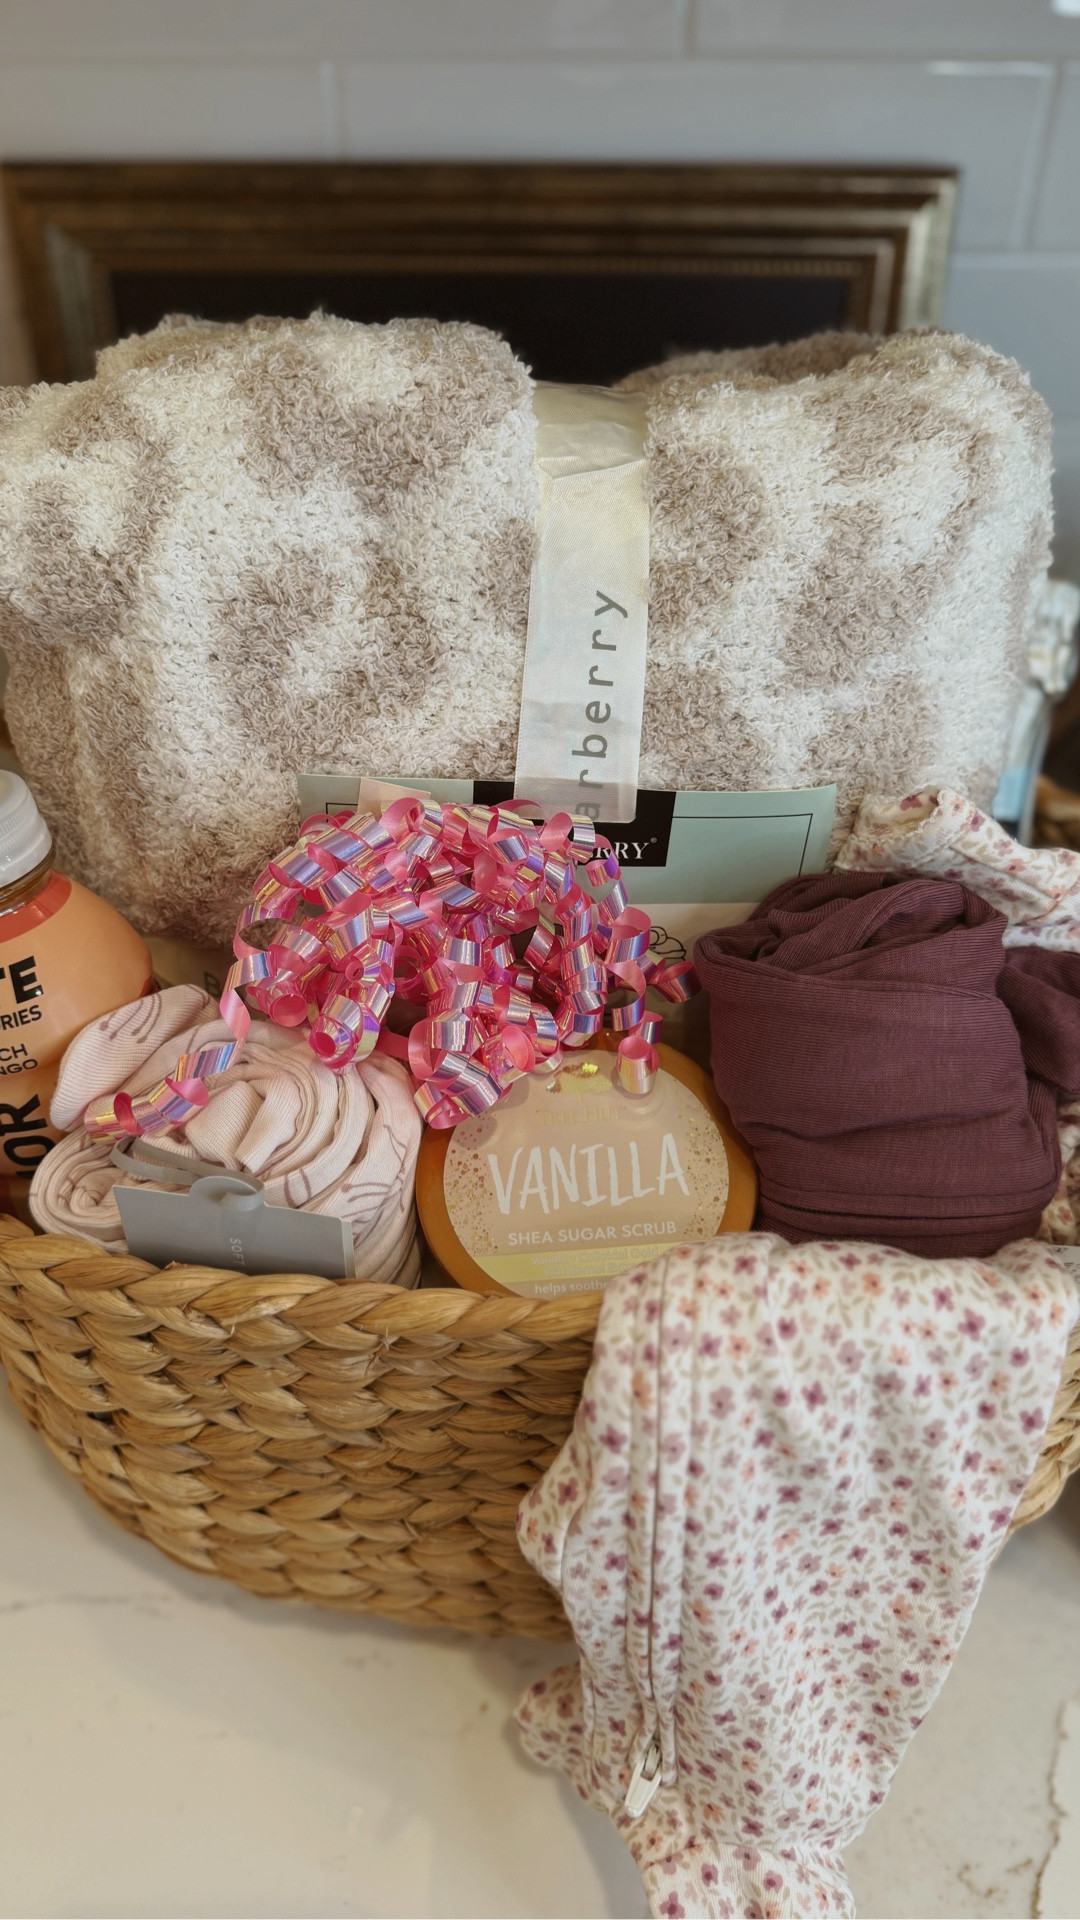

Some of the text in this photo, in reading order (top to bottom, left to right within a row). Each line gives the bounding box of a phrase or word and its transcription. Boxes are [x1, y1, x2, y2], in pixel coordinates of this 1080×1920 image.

[571, 590, 628, 822] arberry
[591, 842, 650, 860] RRY
[0, 955, 44, 1005] E
[0, 1005, 42, 1031] RIES
[487, 1133, 690, 1215] VANILLA
[508, 1221, 677, 1246] SHEA SUGAR SCRUB
[229, 1238, 246, 1266] SOFT
[534, 1283, 567, 1296] helps
